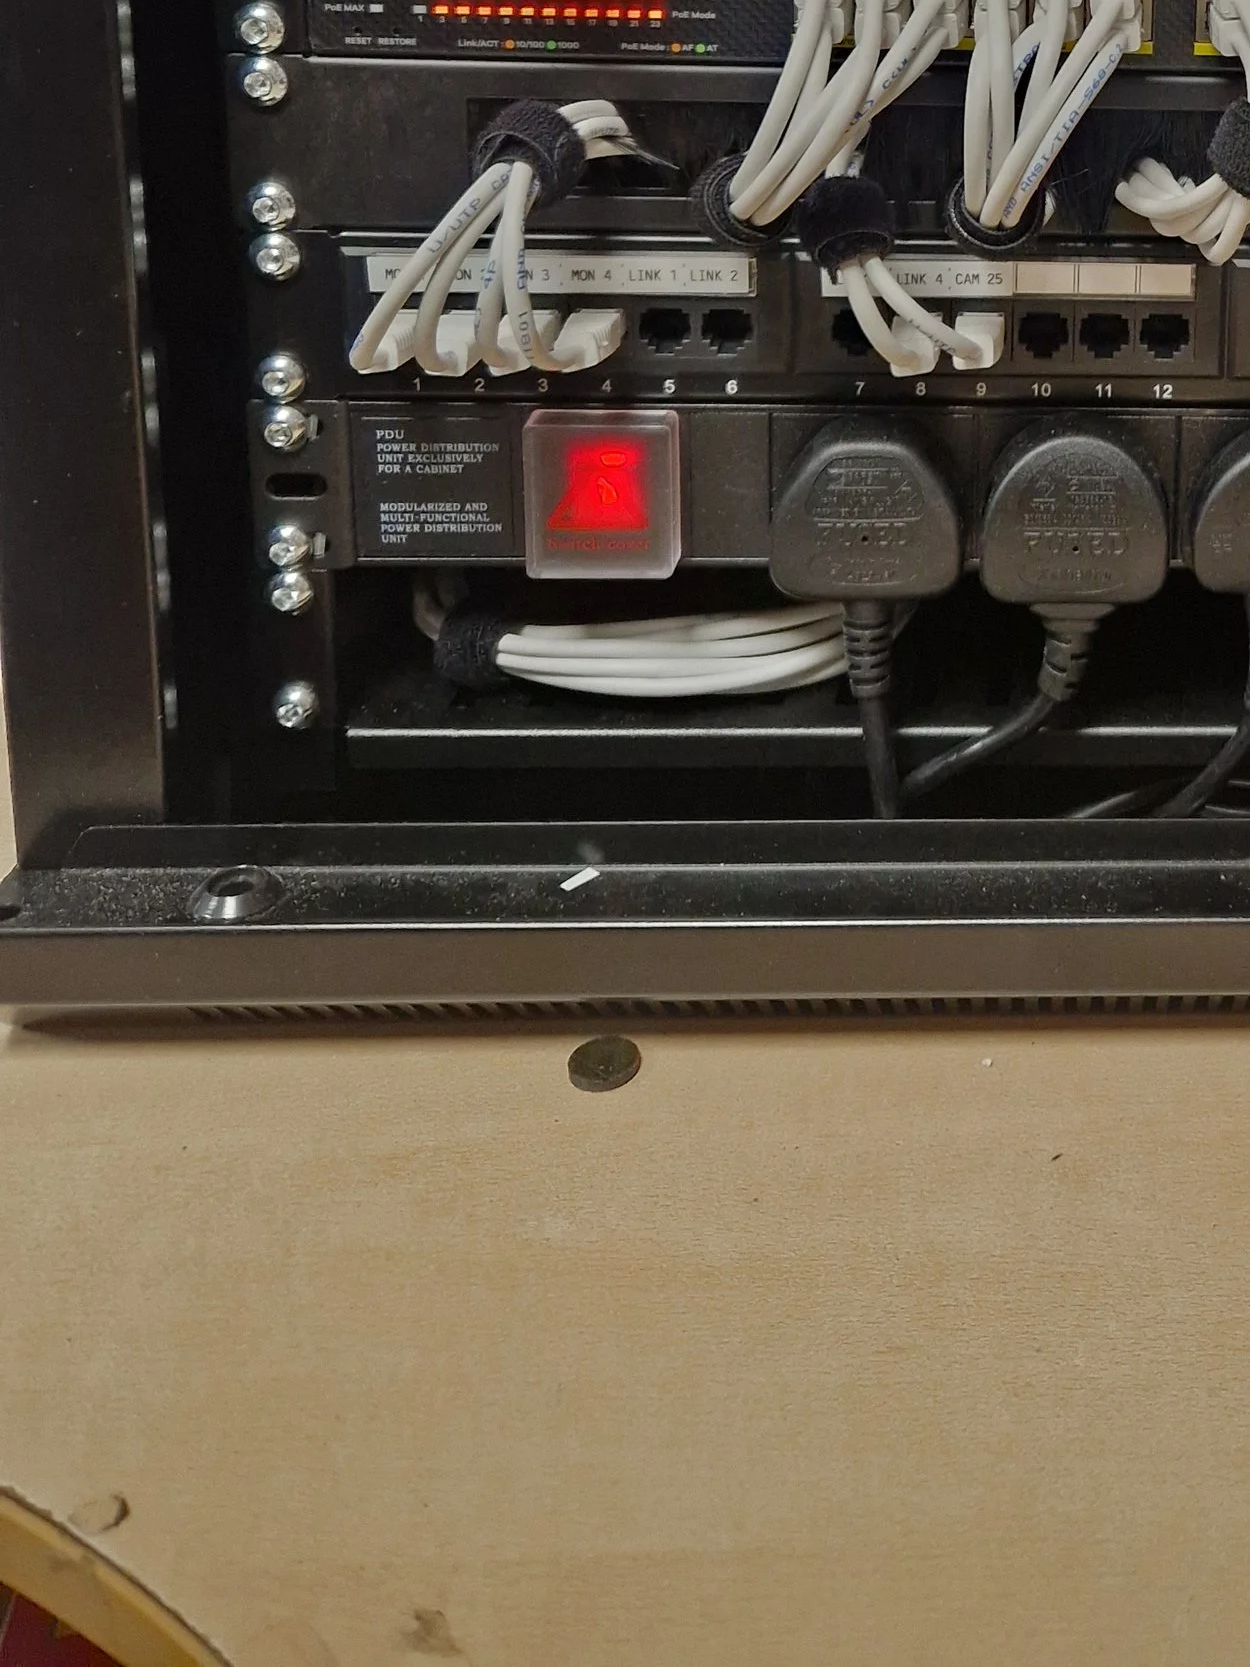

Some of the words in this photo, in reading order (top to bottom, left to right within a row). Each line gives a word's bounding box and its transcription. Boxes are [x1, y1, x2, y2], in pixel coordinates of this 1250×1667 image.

[325, 4, 343, 12] PoE
[344, 4, 365, 12] MAX
[672, 11, 689, 19] PoE
[691, 11, 716, 19] Mode
[345, 37, 372, 45] RESET
[378, 37, 417, 46] RESTORE
[640, 43, 665, 51] Mode
[706, 44, 718, 52] AT
[542, 269, 550, 281] 3
[571, 270, 595, 282] MON
[605, 270, 612, 282] 4
[629, 270, 661, 282] LINK
[672, 270, 677, 282] 1
[690, 270, 722, 282] LINK
[731, 270, 738, 282] 2
[897, 273, 926, 285] LINK
[936, 273, 943, 285] 4
[955, 273, 980, 285] CAM
[988, 273, 1003, 285] 25
[414, 378, 420, 390] 1
[475, 378, 484, 392] 2
[538, 379, 548, 392] 3
[602, 379, 611, 392] 4
[664, 380, 675, 393] 5
[726, 380, 737, 394] 6
[856, 382, 865, 394] 7
[916, 382, 926, 395] 8
[977, 383, 986, 396] 9
[1032, 383, 1051, 396] 10
[1096, 384, 1111, 397] 11
[1154, 384, 1172, 398] 12
[376, 430, 404, 440] PDU
[377, 443, 417, 452] POWER
[421, 443, 499, 453] DISTRIBUTION
[377, 454, 403, 463] UNIT
[408, 454, 483, 463] EXCLUSIVELY
[378, 464, 401, 473] FOR
[404, 465, 412, 473] A
[416, 465, 464, 474] CABINET
[380, 502, 460, 512] MODULARIZED
[465, 502, 488, 511] AND
[380, 513, 490, 522] MULTI-FUNCTIONAL
[381, 524, 420, 533] POWER
[424, 523, 502, 533] DISTRIBUTION
[381, 535, 407, 543] UNIT
